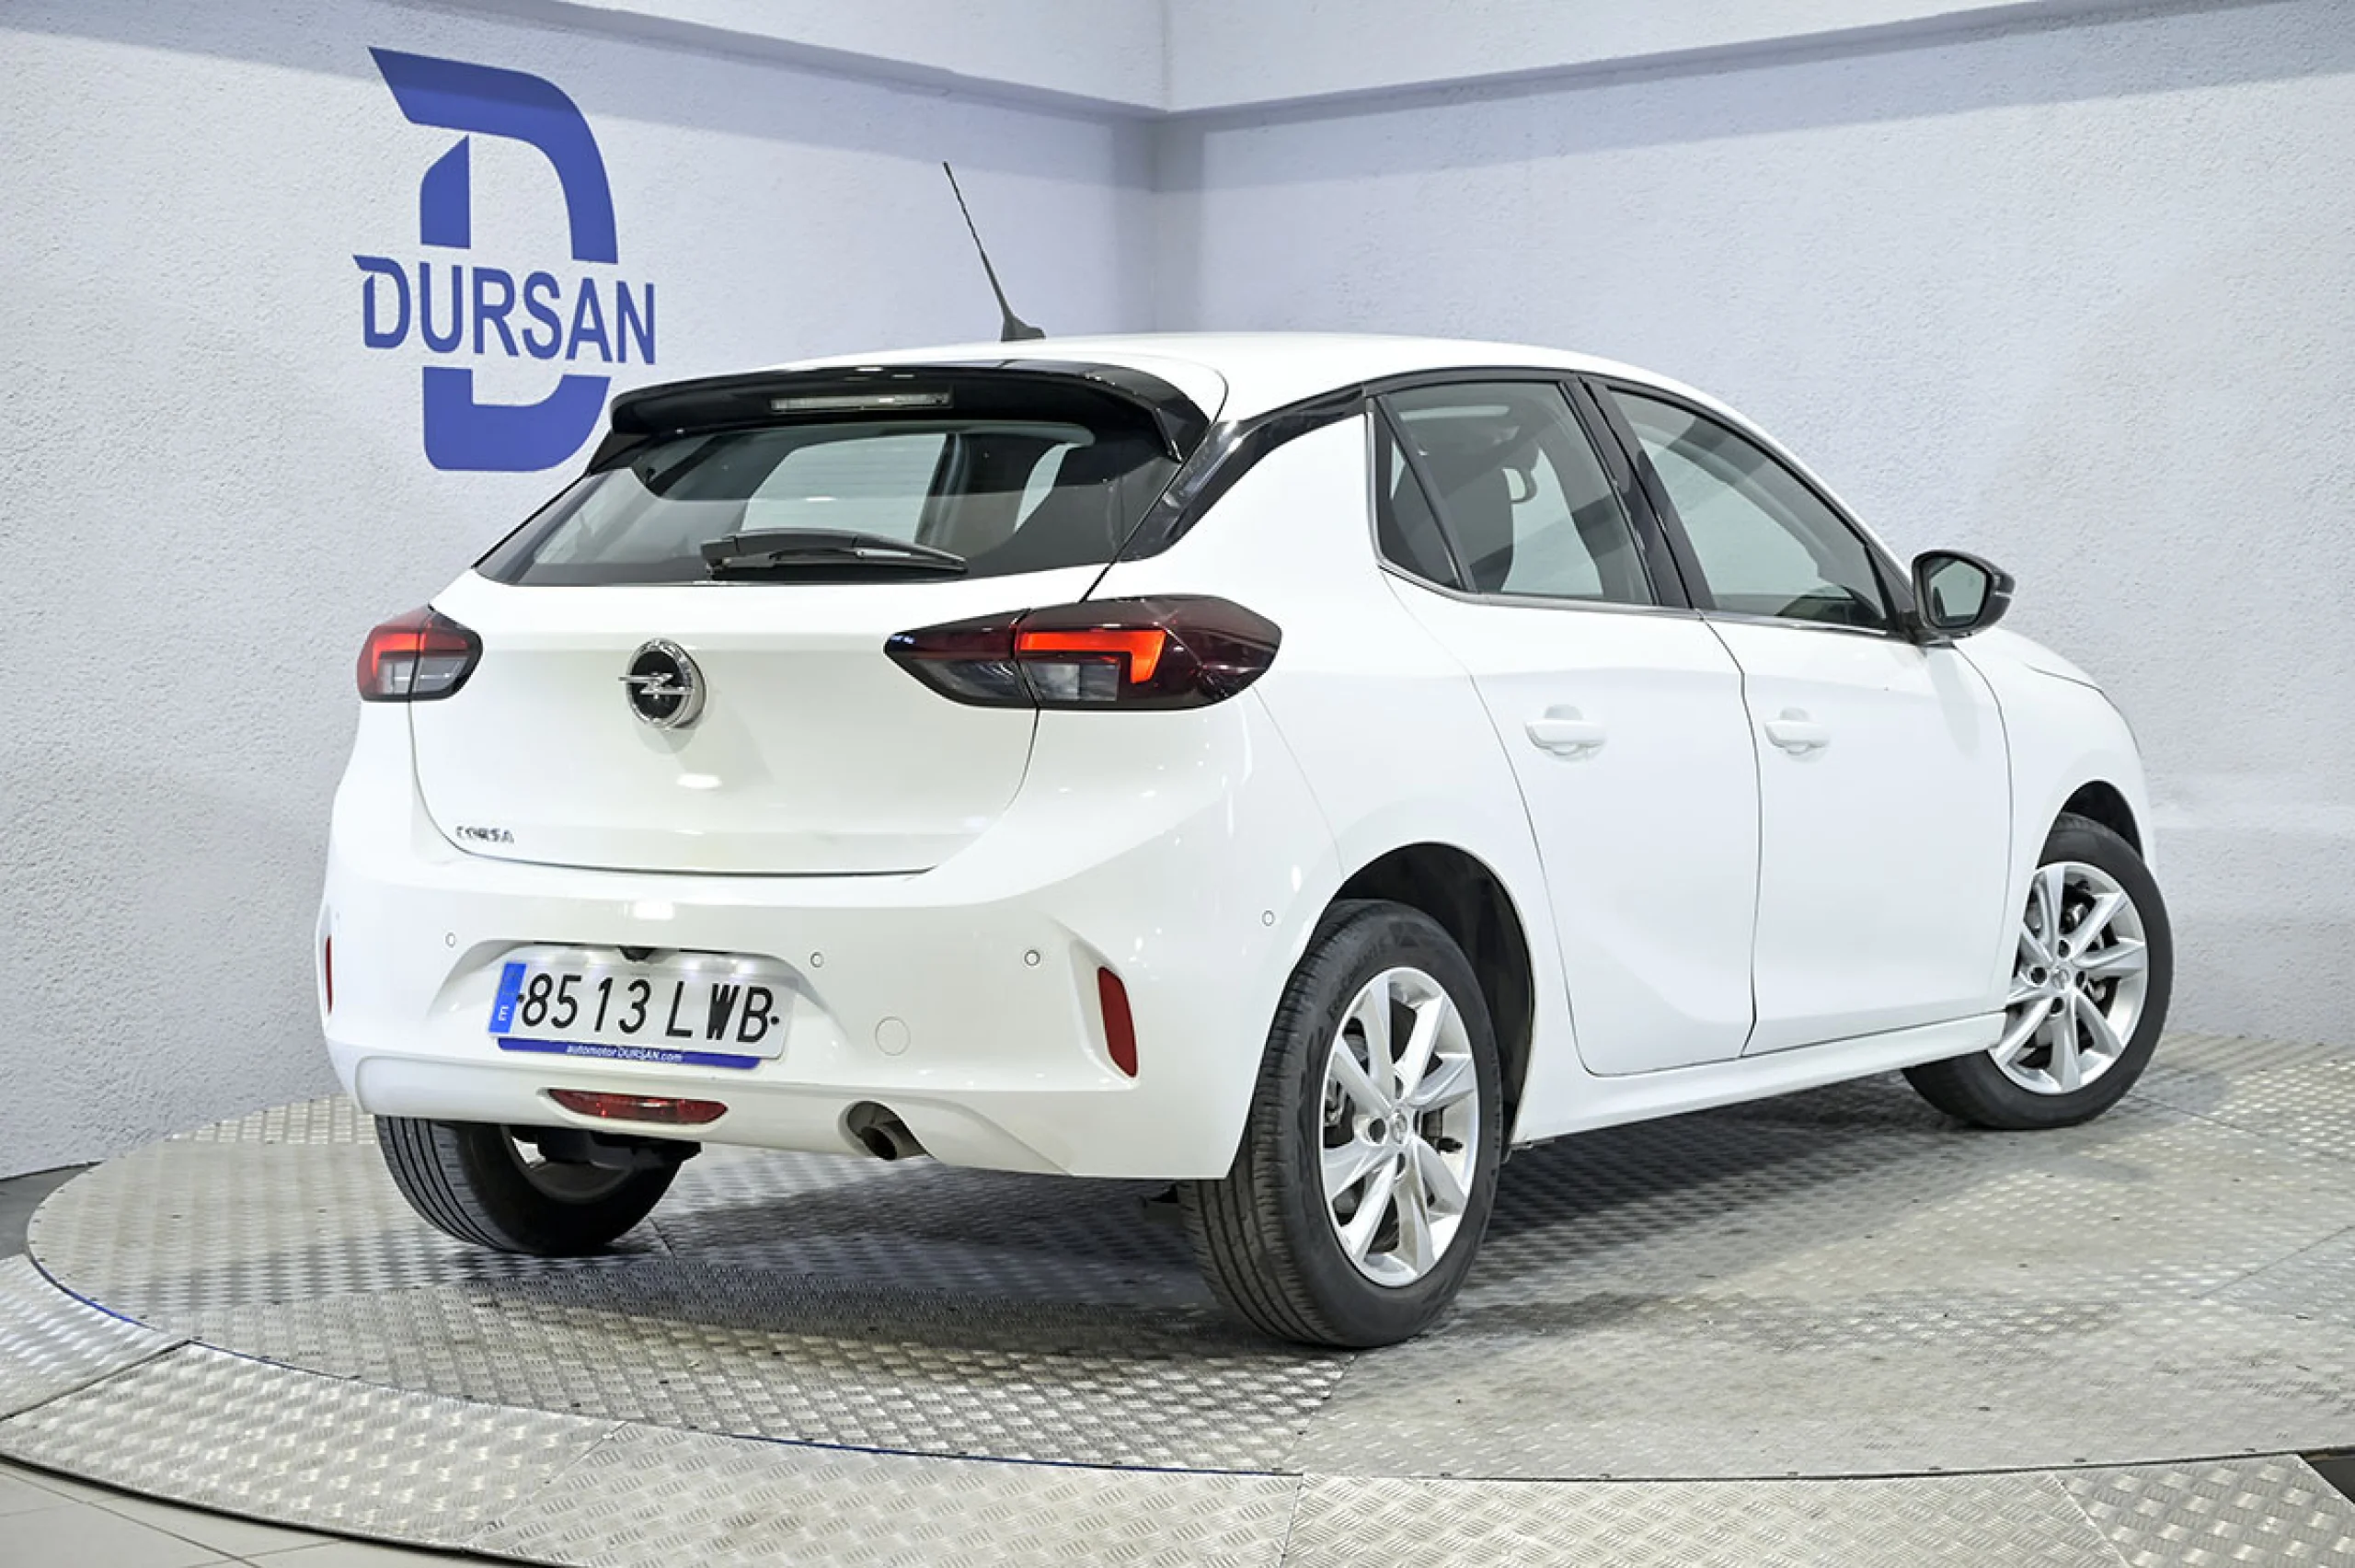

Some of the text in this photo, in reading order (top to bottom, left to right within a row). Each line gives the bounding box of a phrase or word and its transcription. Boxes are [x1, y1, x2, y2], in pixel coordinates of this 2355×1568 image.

[352, 254, 656, 366] DURSAN
[498, 1004, 510, 1022] E
[522, 973, 774, 1043] 8513 LWB
